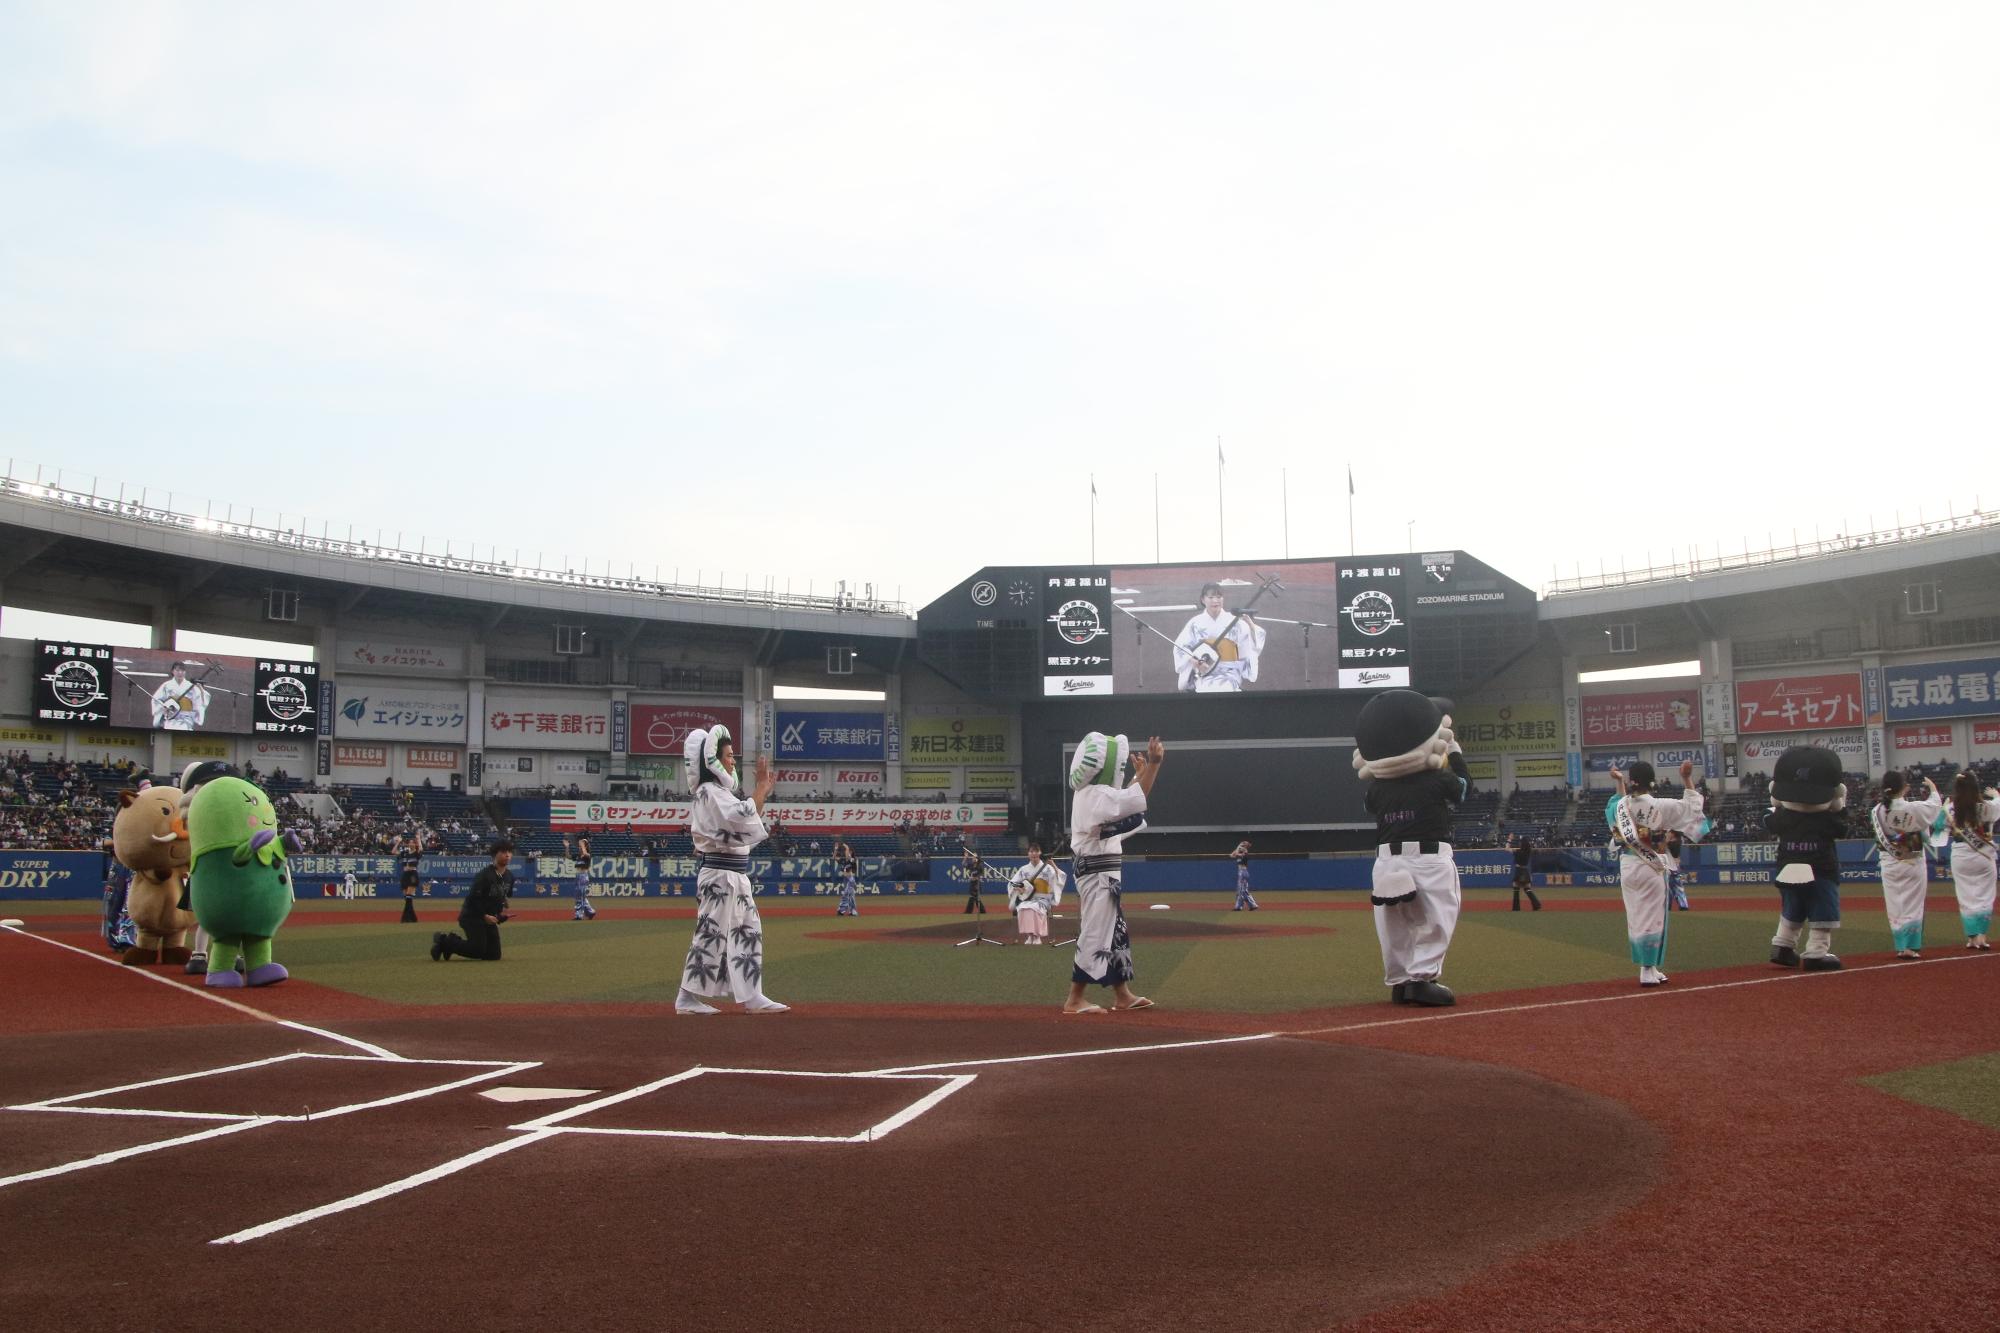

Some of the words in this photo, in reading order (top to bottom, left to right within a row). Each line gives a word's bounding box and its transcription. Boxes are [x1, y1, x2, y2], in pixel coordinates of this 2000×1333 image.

[1341, 567, 1401, 577] 丹波篠山
[1049, 577, 1106, 587] 丹波篠山
[1417, 594, 1468, 604] ZOZOMARINE
[1469, 592, 1505, 601] STADIUM
[976, 620, 994, 628] TIME
[44, 644, 110, 659] 丹波篠山
[1342, 648, 1406, 658] 黒豆ナイター
[1048, 656, 1110, 666] 黒豆ナイター
[258, 662, 316, 675] 丹波篠山
[1357, 671, 1391, 685] Marines
[1062, 678, 1095, 692] Marines
[1889, 671, 2000, 708] 京成電
[39, 709, 107, 721] 黒豆ナイター
[1741, 693, 1860, 727] アーキセプト
[373, 711, 464, 728] エイジェック
[513, 713, 606, 735] 千葉銀行
[1587, 711, 1666, 734] ちば興銀
[255, 722, 314, 734] 黒豆ナイター
[1457, 721, 1556, 742] 新日本建設
[817, 728, 882, 745] 京葉銀行
[1976, 730, 2000, 741] 宇野
[911, 735, 1005, 752] 新日本建設
[338, 748, 383, 759] B.I.TECH
[411, 750, 454, 762] B.I.TECH
[1657, 750, 1703, 763] OGURA
[607, 806, 690, 819] セブン-イレブン
[842, 809, 952, 821] チケットのお求めは
[1741, 844, 1778, 863] 新昭
[12, 860, 49, 869] SUPER
[1458, 865, 1511, 875] 三井住友銀行
[1733, 871, 1770, 882] 新昭和
[336, 883, 376, 896] KIKE
